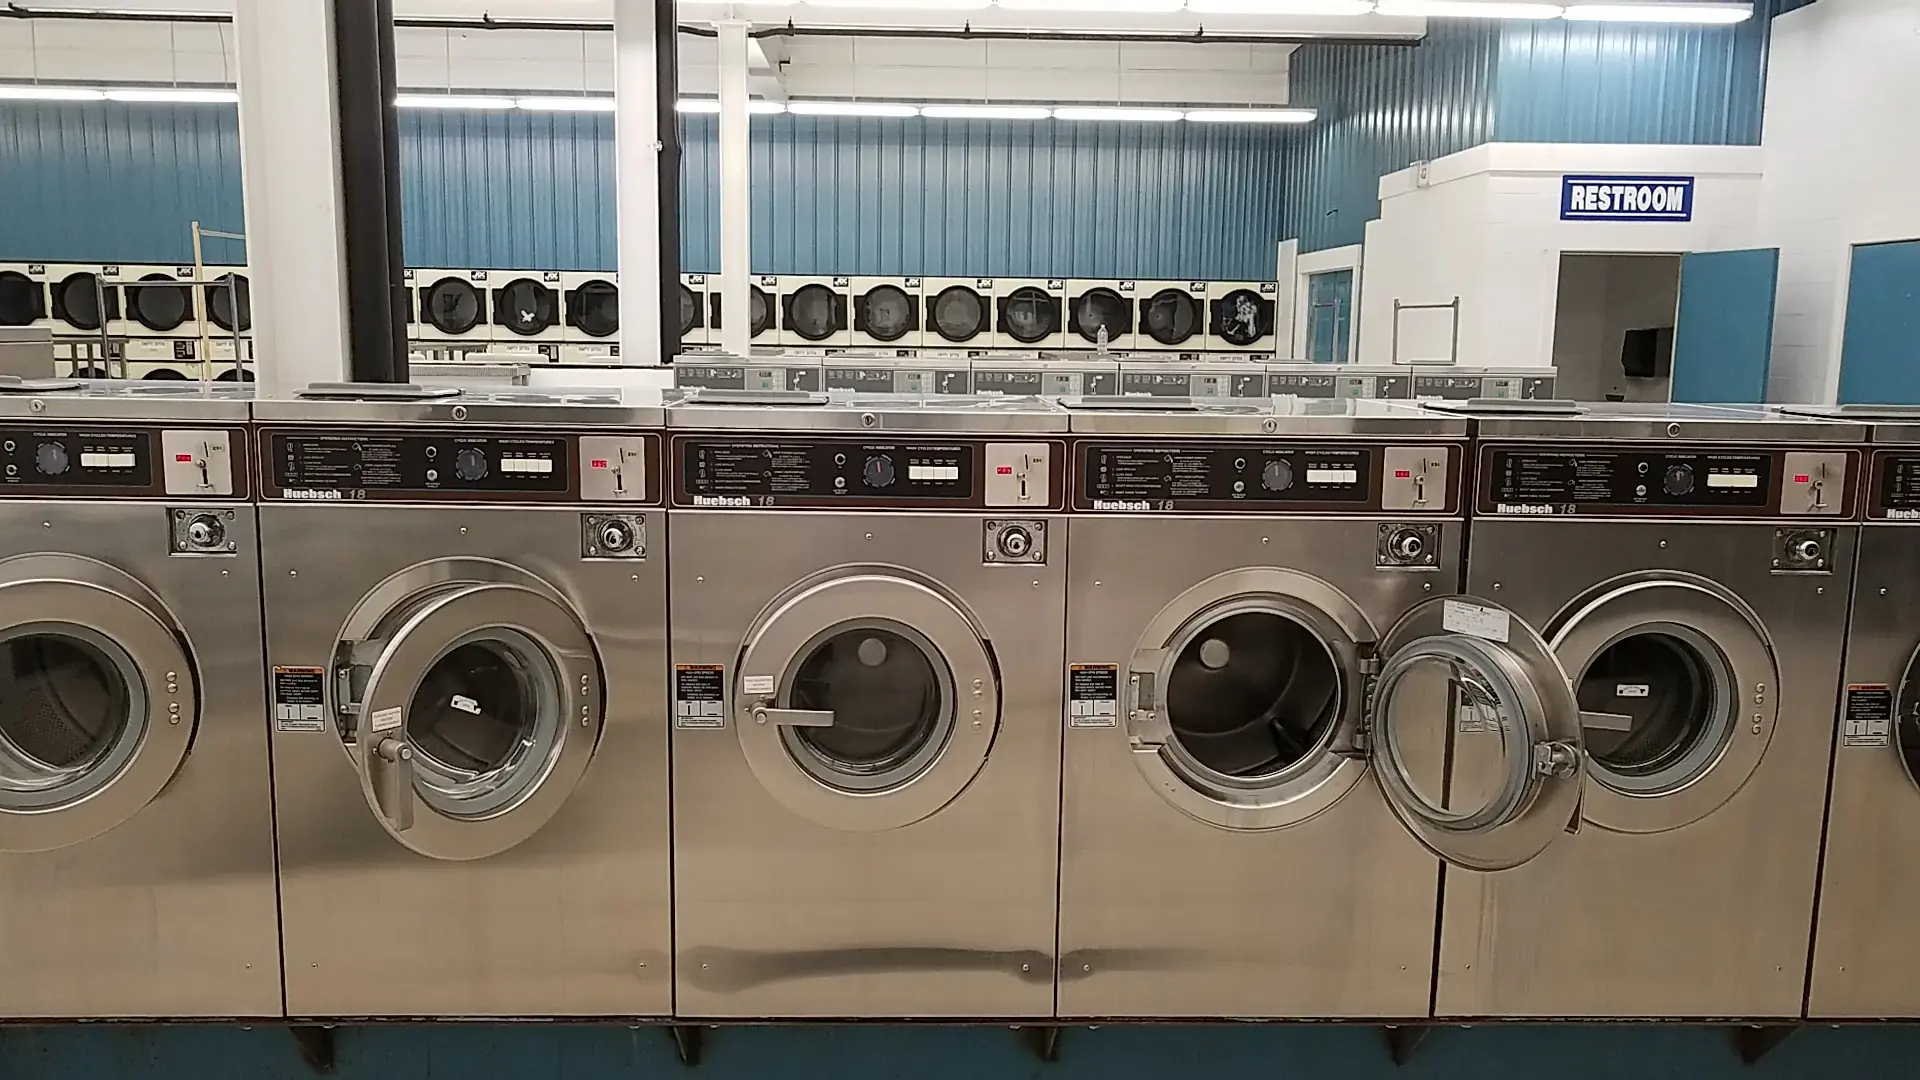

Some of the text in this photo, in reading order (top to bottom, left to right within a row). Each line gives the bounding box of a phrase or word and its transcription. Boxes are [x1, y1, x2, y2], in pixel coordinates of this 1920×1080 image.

[1571, 185, 1684, 211] RESTROOM
[283, 488, 366, 500] Huebsch 18
[693, 495, 775, 507] Huebsch 18
[1093, 500, 1174, 511] Huebsch 18
[1497, 503, 1576, 515] Huebsch 18
